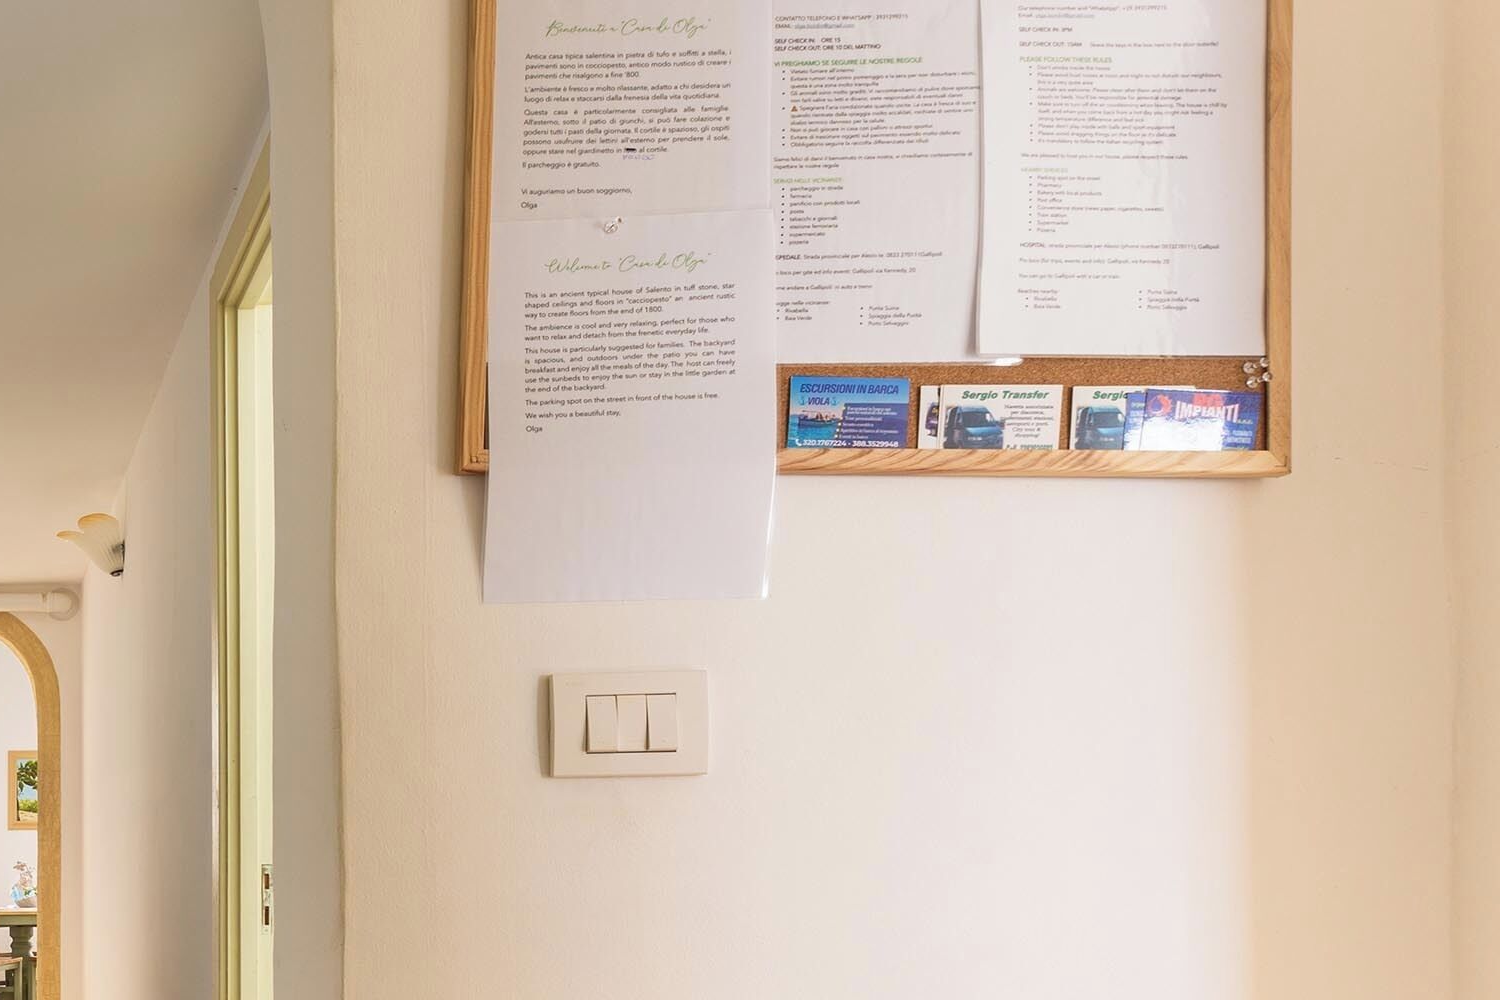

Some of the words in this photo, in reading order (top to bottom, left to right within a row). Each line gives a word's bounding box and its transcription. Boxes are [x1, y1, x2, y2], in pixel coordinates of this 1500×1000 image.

[544, 258, 600, 273] Welcome
[551, 300, 578, 308] ceilings
[800, 384, 855, 394] ESCURSIONI
[856, 384, 867, 394] IN
[868, 384, 899, 395] BARCA
[962, 390, 998, 401] Sergio
[1002, 390, 1049, 399] Transfer
[808, 397, 830, 406] VIOLA
[1176, 401, 1239, 423] IMPIANTI
[525, 425, 543, 433] Olga
